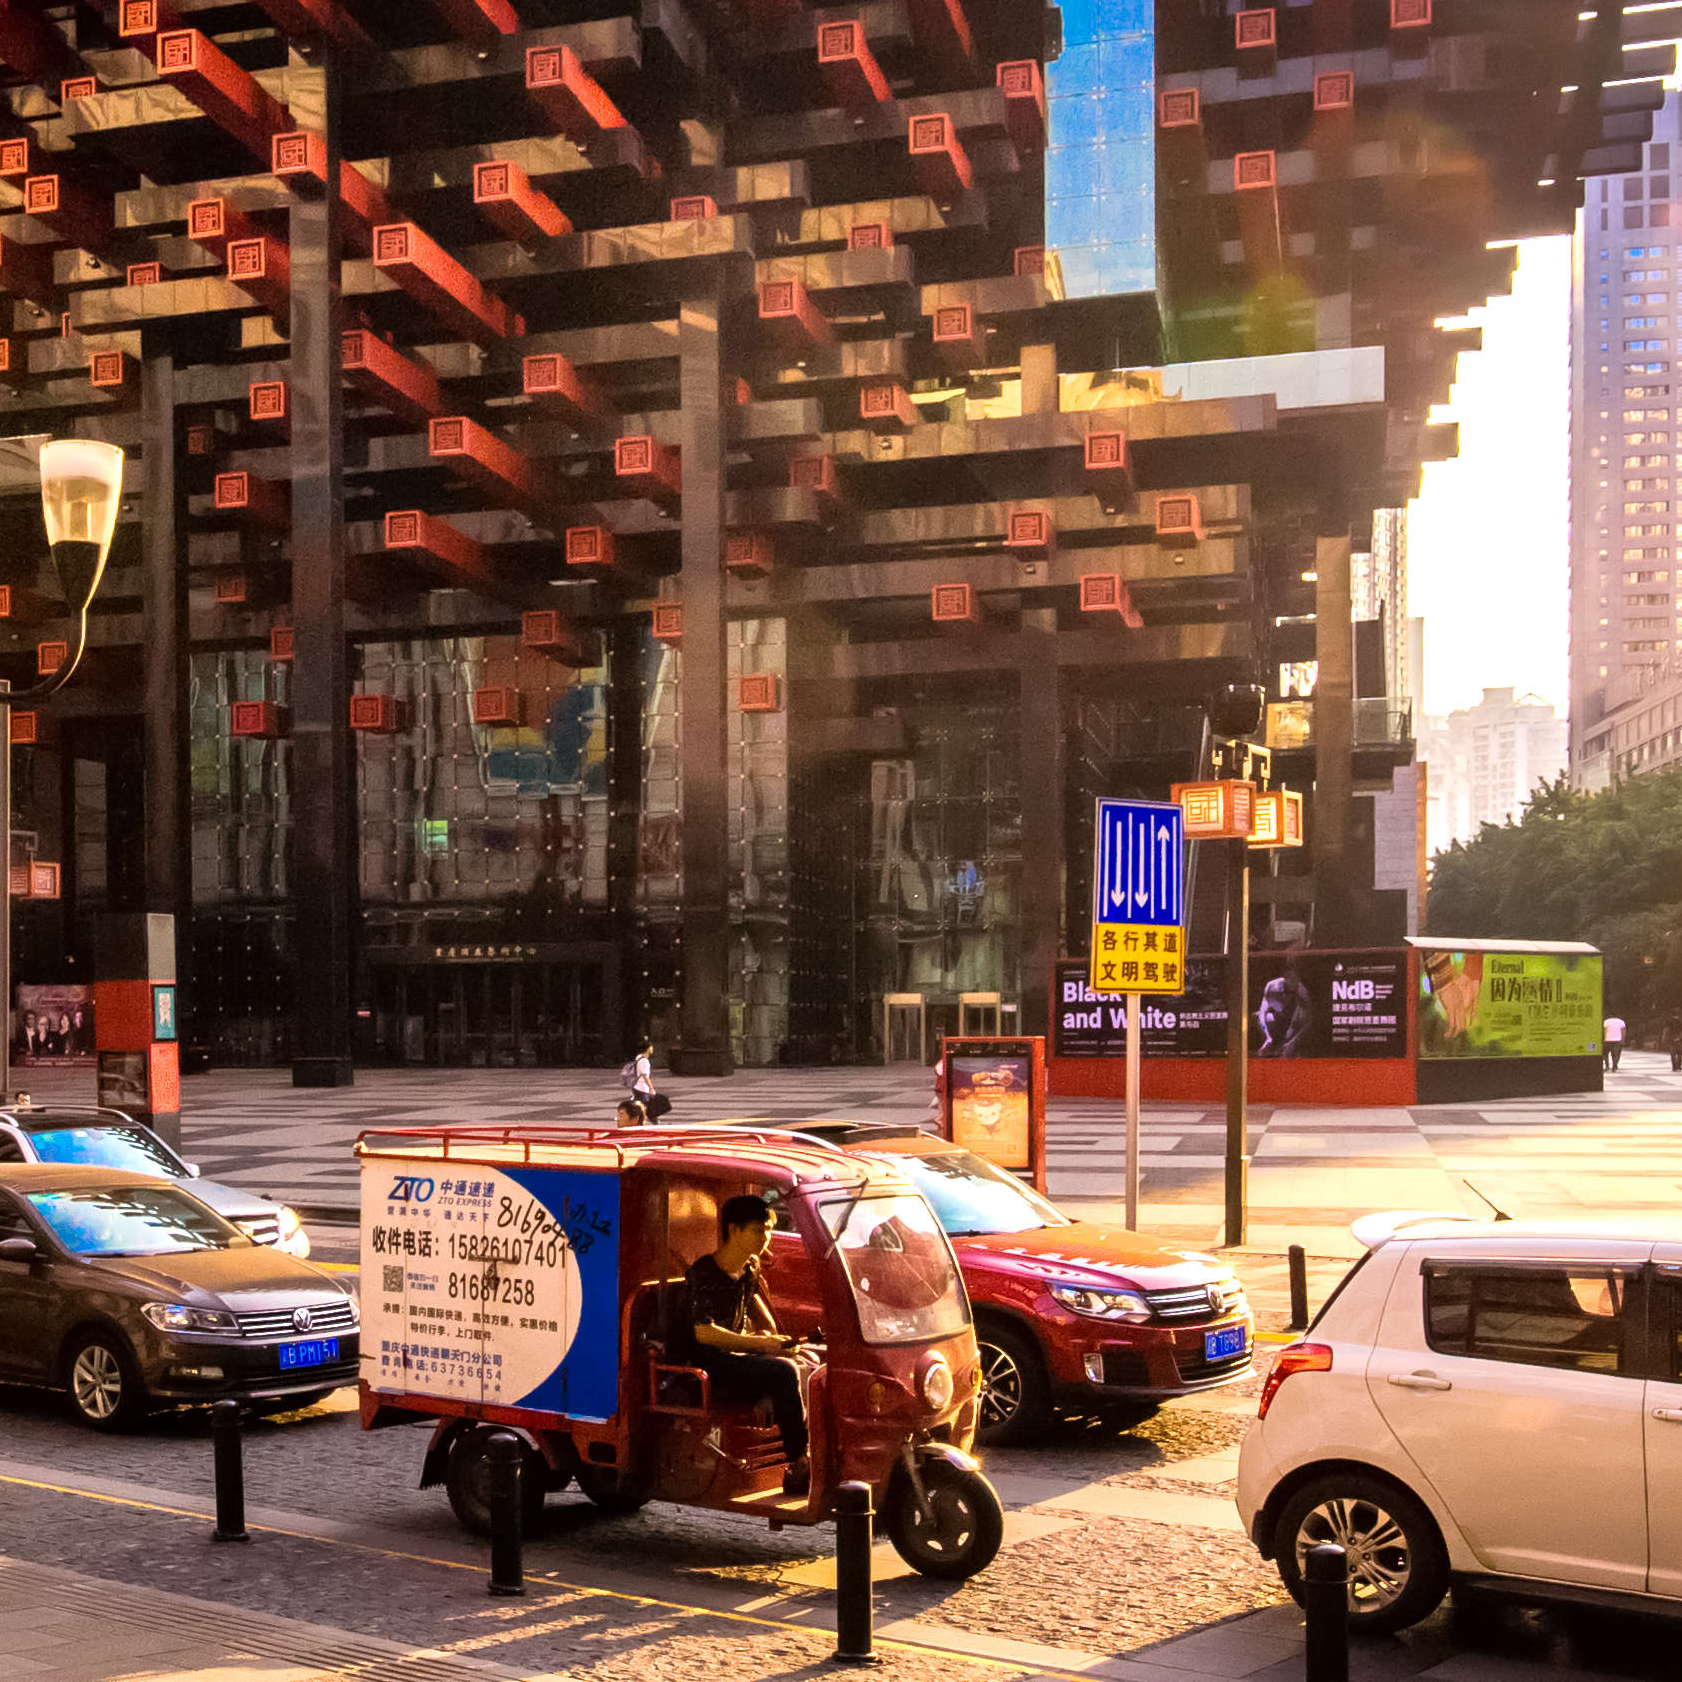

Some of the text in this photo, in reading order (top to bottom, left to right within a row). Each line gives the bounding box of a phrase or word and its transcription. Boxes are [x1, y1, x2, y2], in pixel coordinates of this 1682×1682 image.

[1102, 929, 1178, 953] 各行其道
[1100, 960, 1178, 983] 文明驾驶
[1332, 980, 1375, 1000] NdB
[1063, 1006, 1102, 1029] and
[388, 1175, 435, 1202] ZTO
[438, 1196, 493, 1208] ZTO EXPRESS
[449, 1232, 567, 1269] 15826107401
[448, 1271, 535, 1306] 81687258
